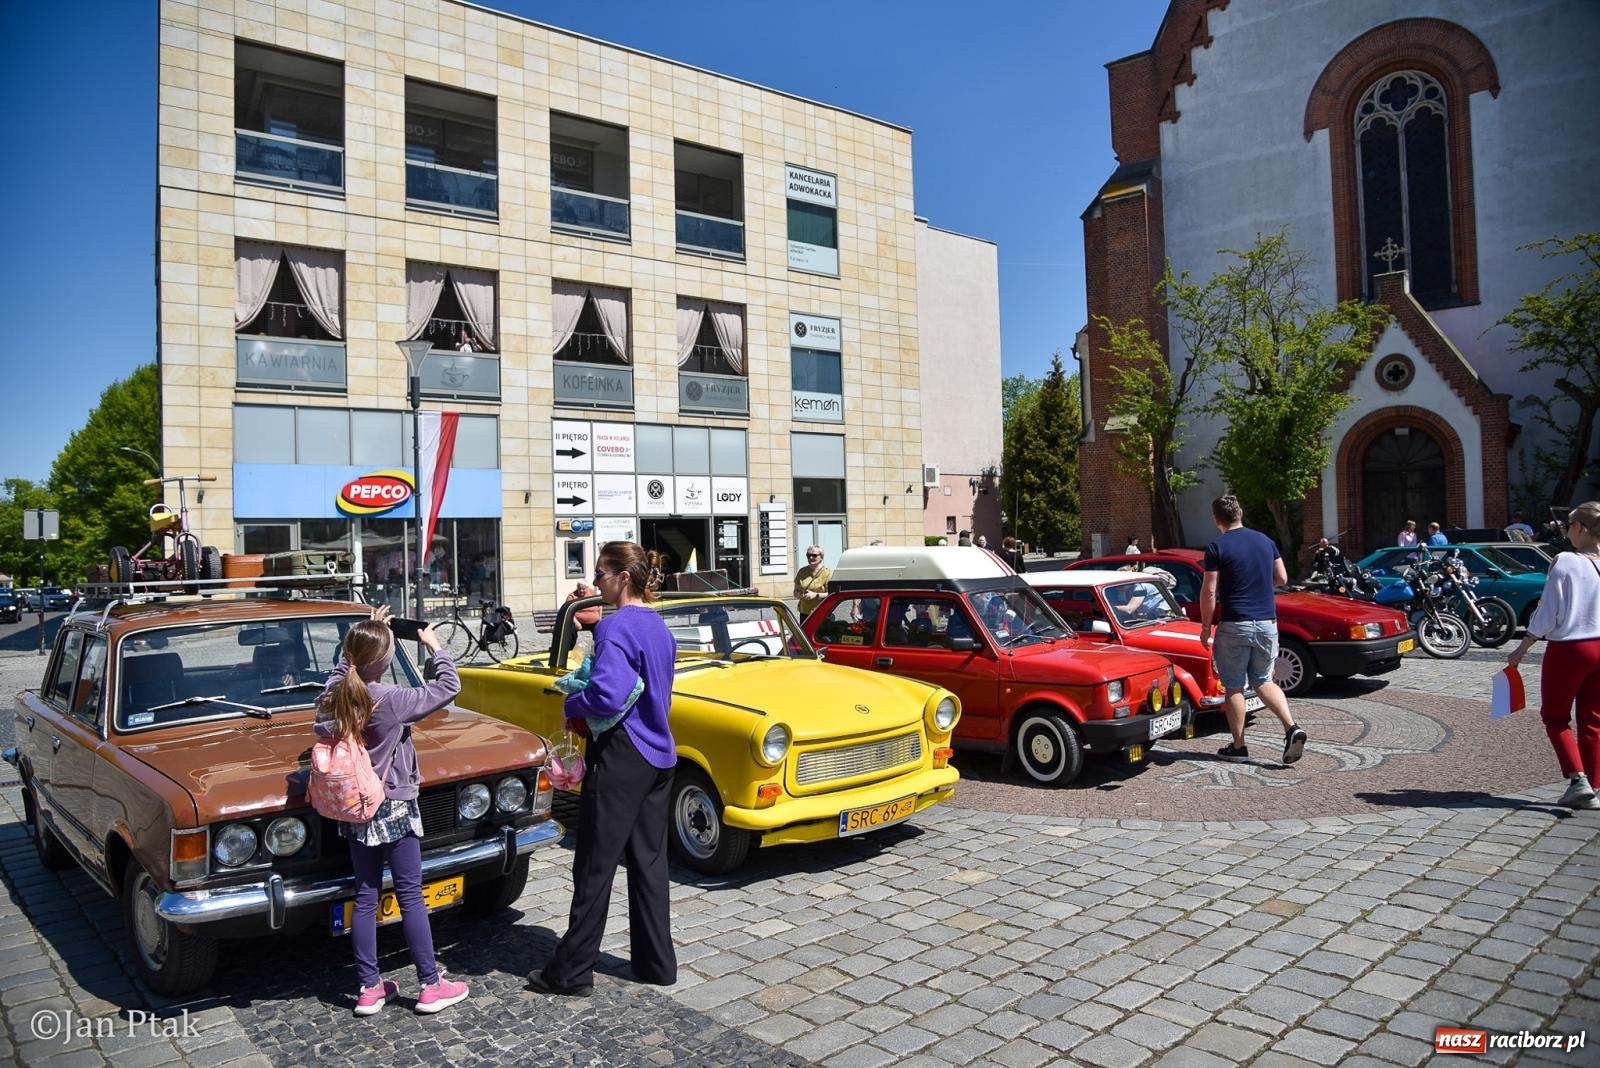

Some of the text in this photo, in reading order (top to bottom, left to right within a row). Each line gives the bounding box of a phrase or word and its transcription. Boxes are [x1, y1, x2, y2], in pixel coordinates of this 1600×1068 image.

[789, 171, 831, 188] KANCELARIA
[789, 183, 832, 199] ADWOKACKA
[245, 352, 338, 372] KAWIARNIA
[562, 374, 624, 393] KOFEINKA
[562, 433, 588, 442] PIĘTRO
[597, 445, 625, 453] COVEBO
[350, 484, 406, 499] PEPCO
[561, 481, 588, 490] PIĘTRO
[716, 492, 742, 502] LODY
[850, 803, 898, 829] SRC 69
